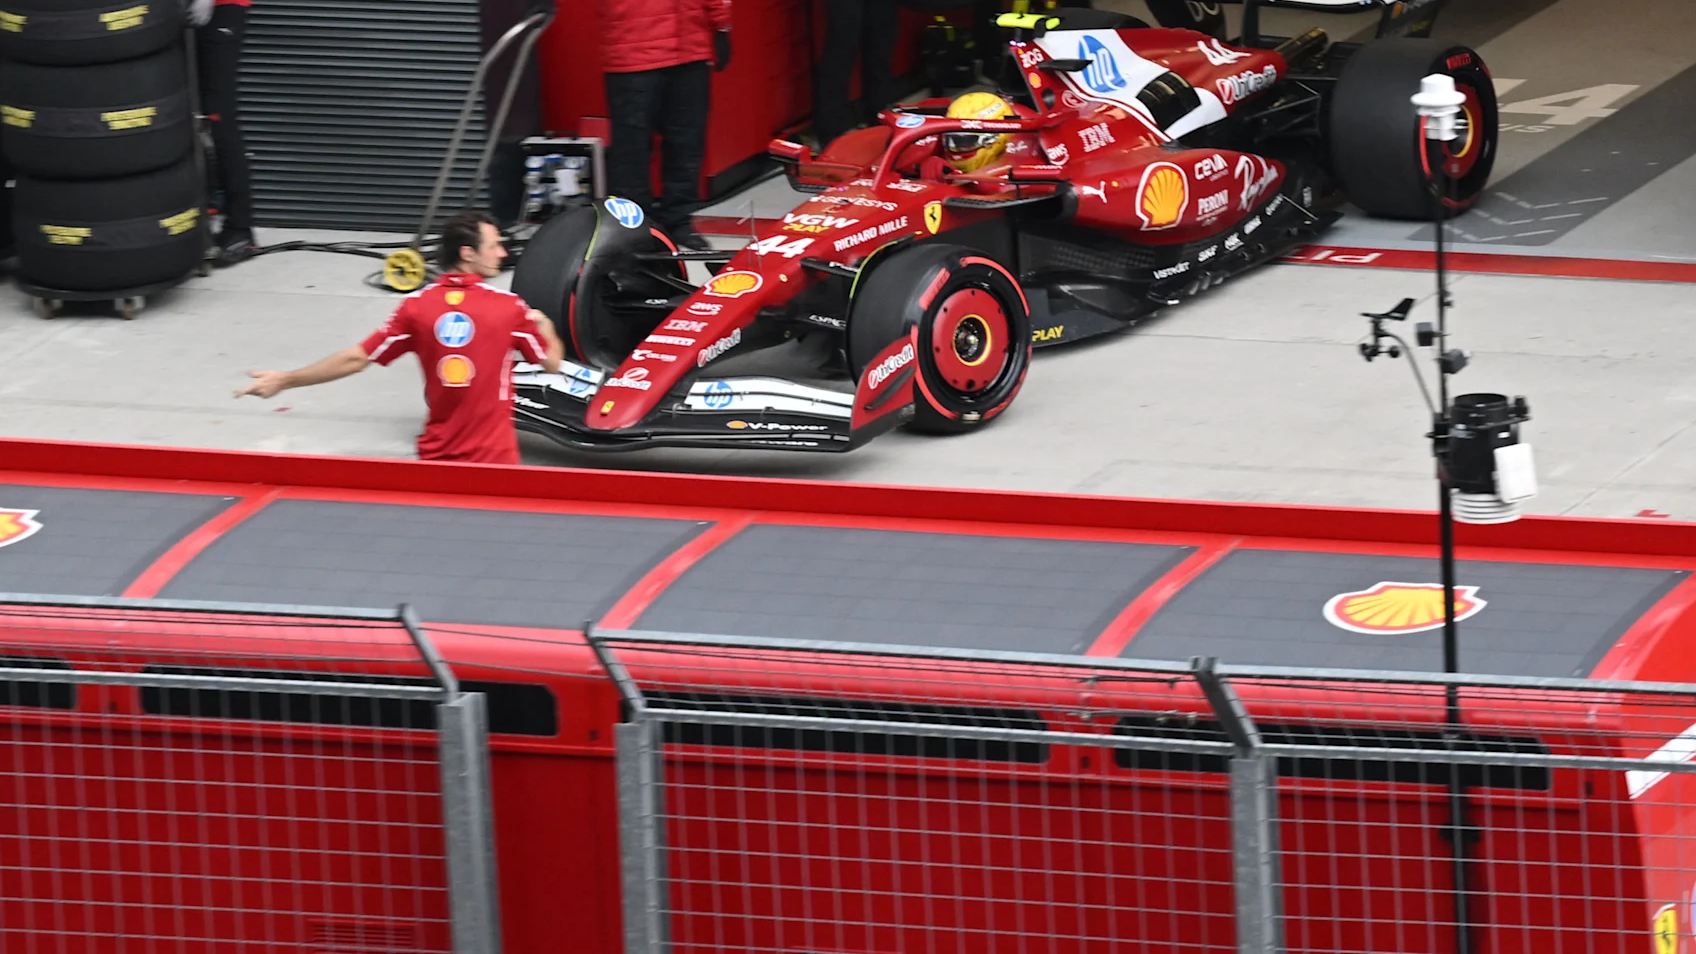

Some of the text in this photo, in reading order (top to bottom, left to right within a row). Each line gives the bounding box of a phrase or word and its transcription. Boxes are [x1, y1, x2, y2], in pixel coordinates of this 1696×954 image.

[1078, 35, 1127, 92] hp
[1197, 38, 1252, 65] 44
[1077, 122, 1115, 152] IBM
[1047, 143, 1068, 160] aws
[604, 198, 644, 228] hp
[822, 196, 898, 211] GENESYS
[1198, 189, 1229, 215] PERONI
[783, 213, 859, 228] VGW
[783, 224, 830, 233] PLAY
[833, 216, 908, 252] RICHARD MILLE
[746, 235, 815, 259] 44
[690, 302, 723, 312] aws
[664, 319, 708, 332] IBM
[1032, 325, 1064, 342] PLAY
[877, 343, 914, 382] UniCredit
[703, 381, 733, 408] hp
[748, 422, 829, 431] V-Power
